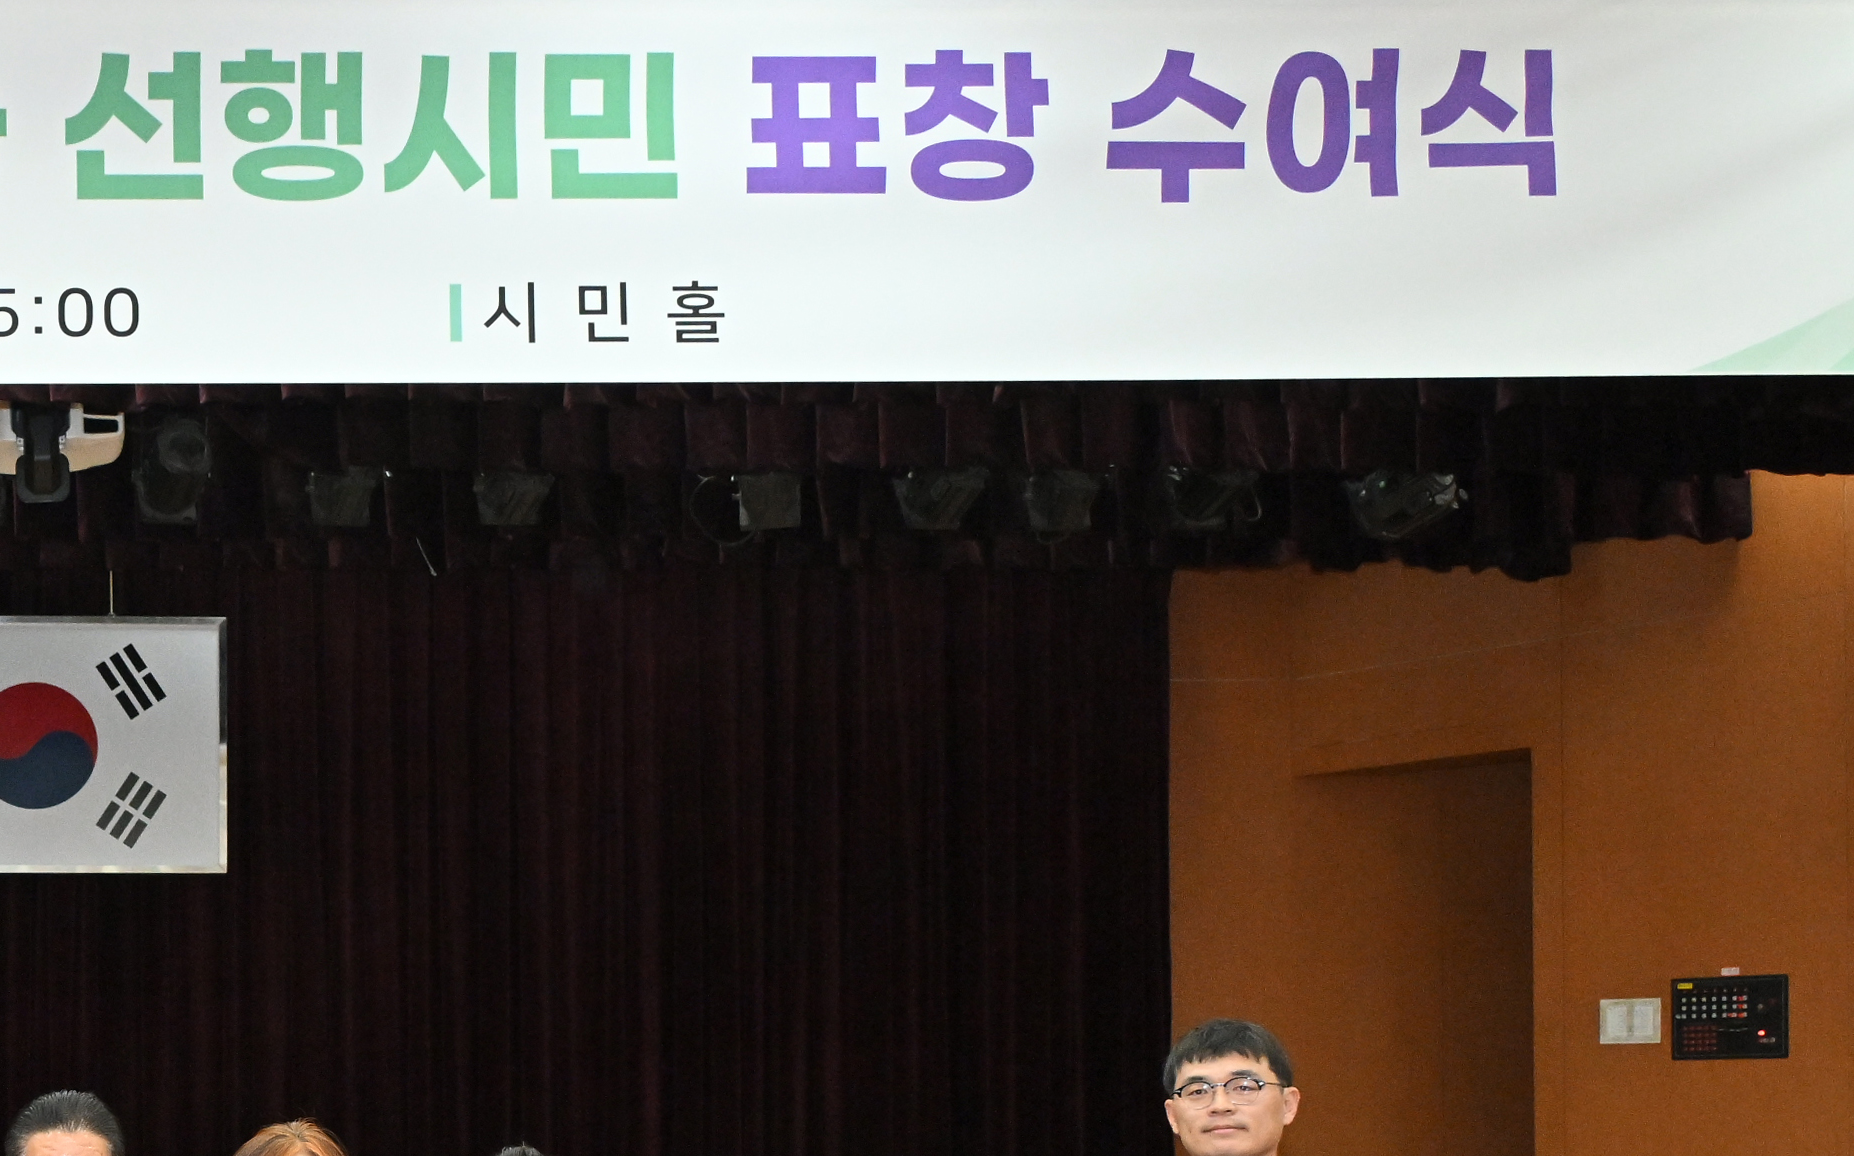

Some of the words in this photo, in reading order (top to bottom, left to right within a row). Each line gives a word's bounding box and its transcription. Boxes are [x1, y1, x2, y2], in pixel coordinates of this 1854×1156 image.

[64, 48, 678, 202] 선행시민
[746, 49, 1050, 202] 표창
[1106, 47, 1557, 203] 수여식
